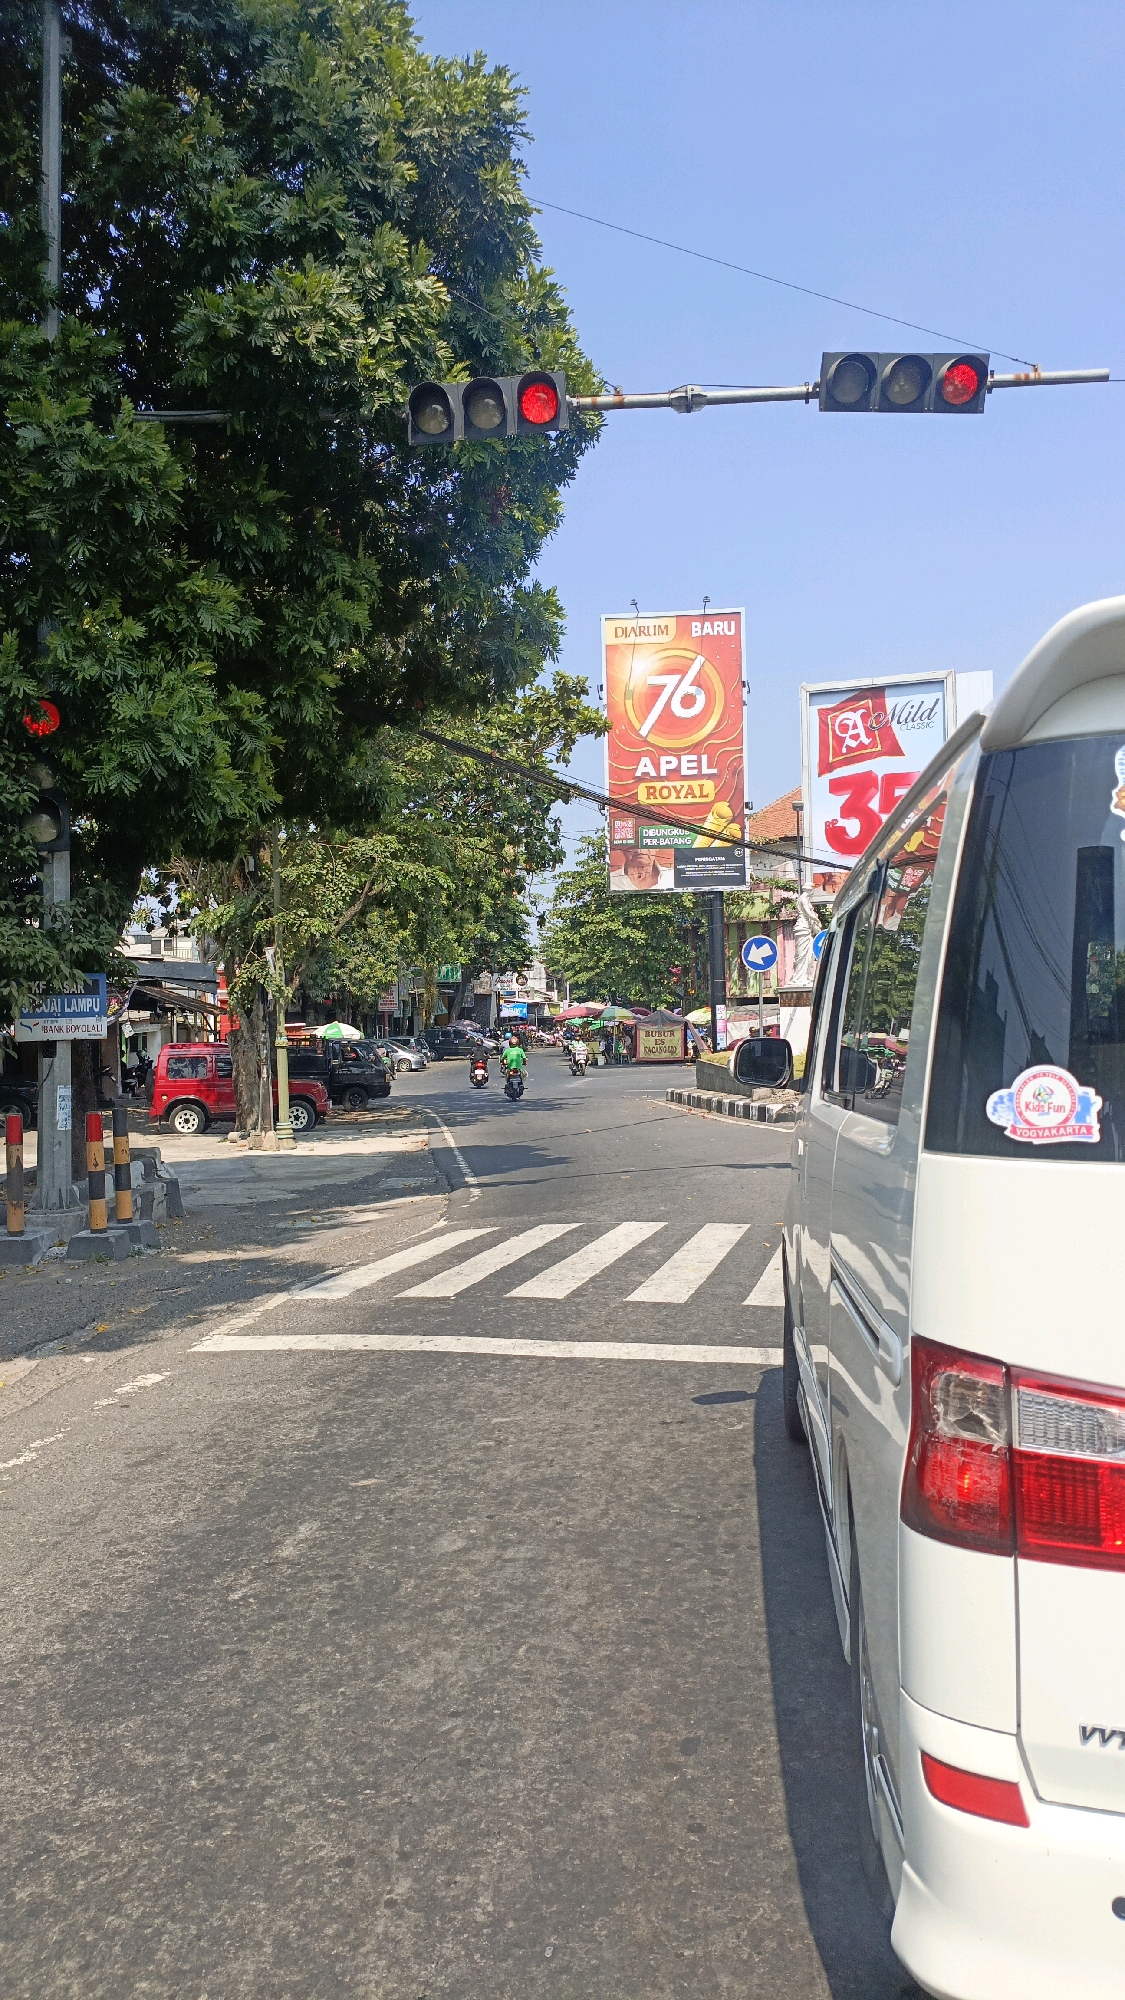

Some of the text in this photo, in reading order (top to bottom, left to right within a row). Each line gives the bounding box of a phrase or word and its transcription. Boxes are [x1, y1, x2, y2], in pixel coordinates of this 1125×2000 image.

[614, 624, 669, 638] DJARUM
[691, 620, 736, 638] BARU
[638, 654, 706, 738] 76
[868, 698, 941, 731] Mild
[900, 721, 935, 731] CLASSIC
[634, 753, 718, 777] APEL
[644, 783, 710, 800] ROYAL
[642, 837, 692, 846] PER-BATANG
[64, 997, 100, 1013] LAMPU
[43, 1024, 103, 1034] BANK BOYOLALI
[1024, 1101, 1066, 1113] Kids Fun
[1016, 1125, 1088, 1138] YOGYAKARTA
